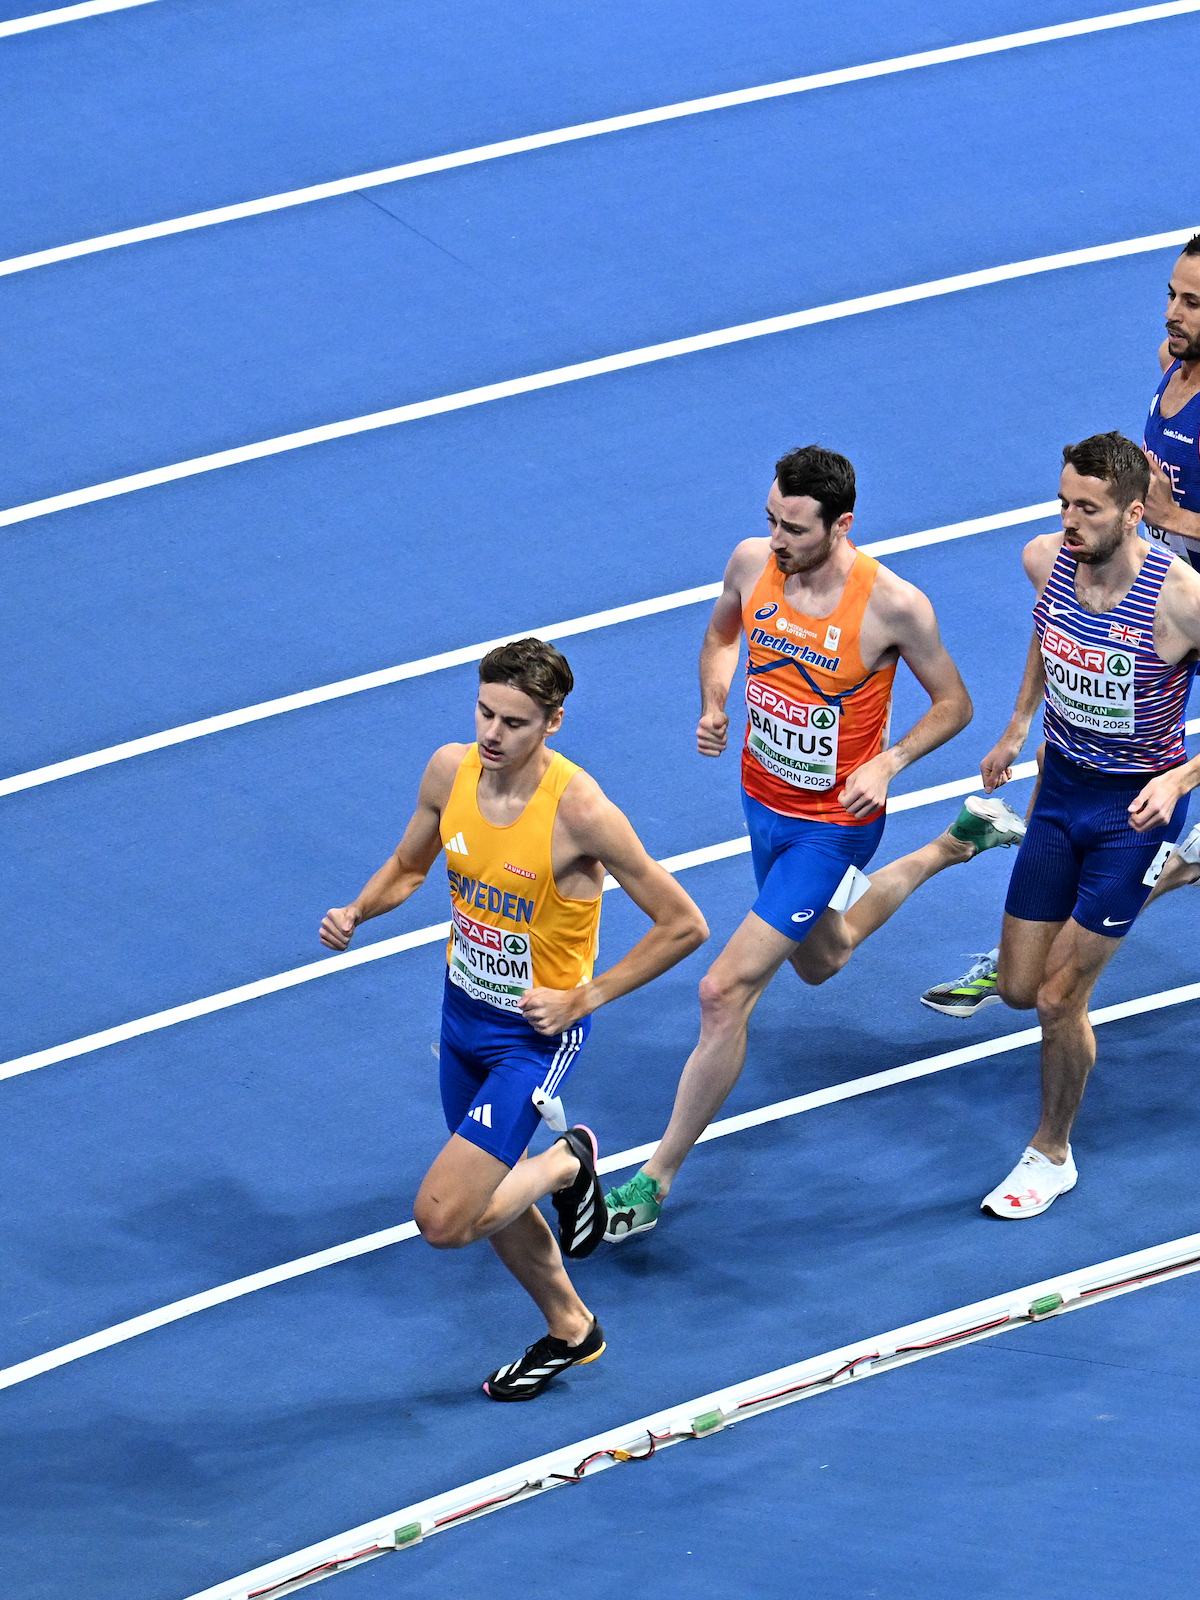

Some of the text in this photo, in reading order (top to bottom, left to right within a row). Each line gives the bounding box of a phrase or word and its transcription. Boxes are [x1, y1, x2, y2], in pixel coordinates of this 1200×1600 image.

[1044, 630, 1104, 670] SPAR
[1045, 656, 1131, 701] GOURLEY
[748, 684, 807, 724] SPAR
[1076, 702, 1108, 715] CLEAN
[750, 708, 833, 757] BALTUS
[1103, 720, 1130, 729] 2025
[764, 746, 779, 760] RUN
[779, 755, 809, 771] CLEAN
[804, 776, 831, 787] 2025
[504, 862, 536, 879] BAUHAUS
[447, 869, 535, 925] SWEDEN
[453, 971, 518, 1008] APELDOORN 20
[479, 979, 509, 993] CLEAN
